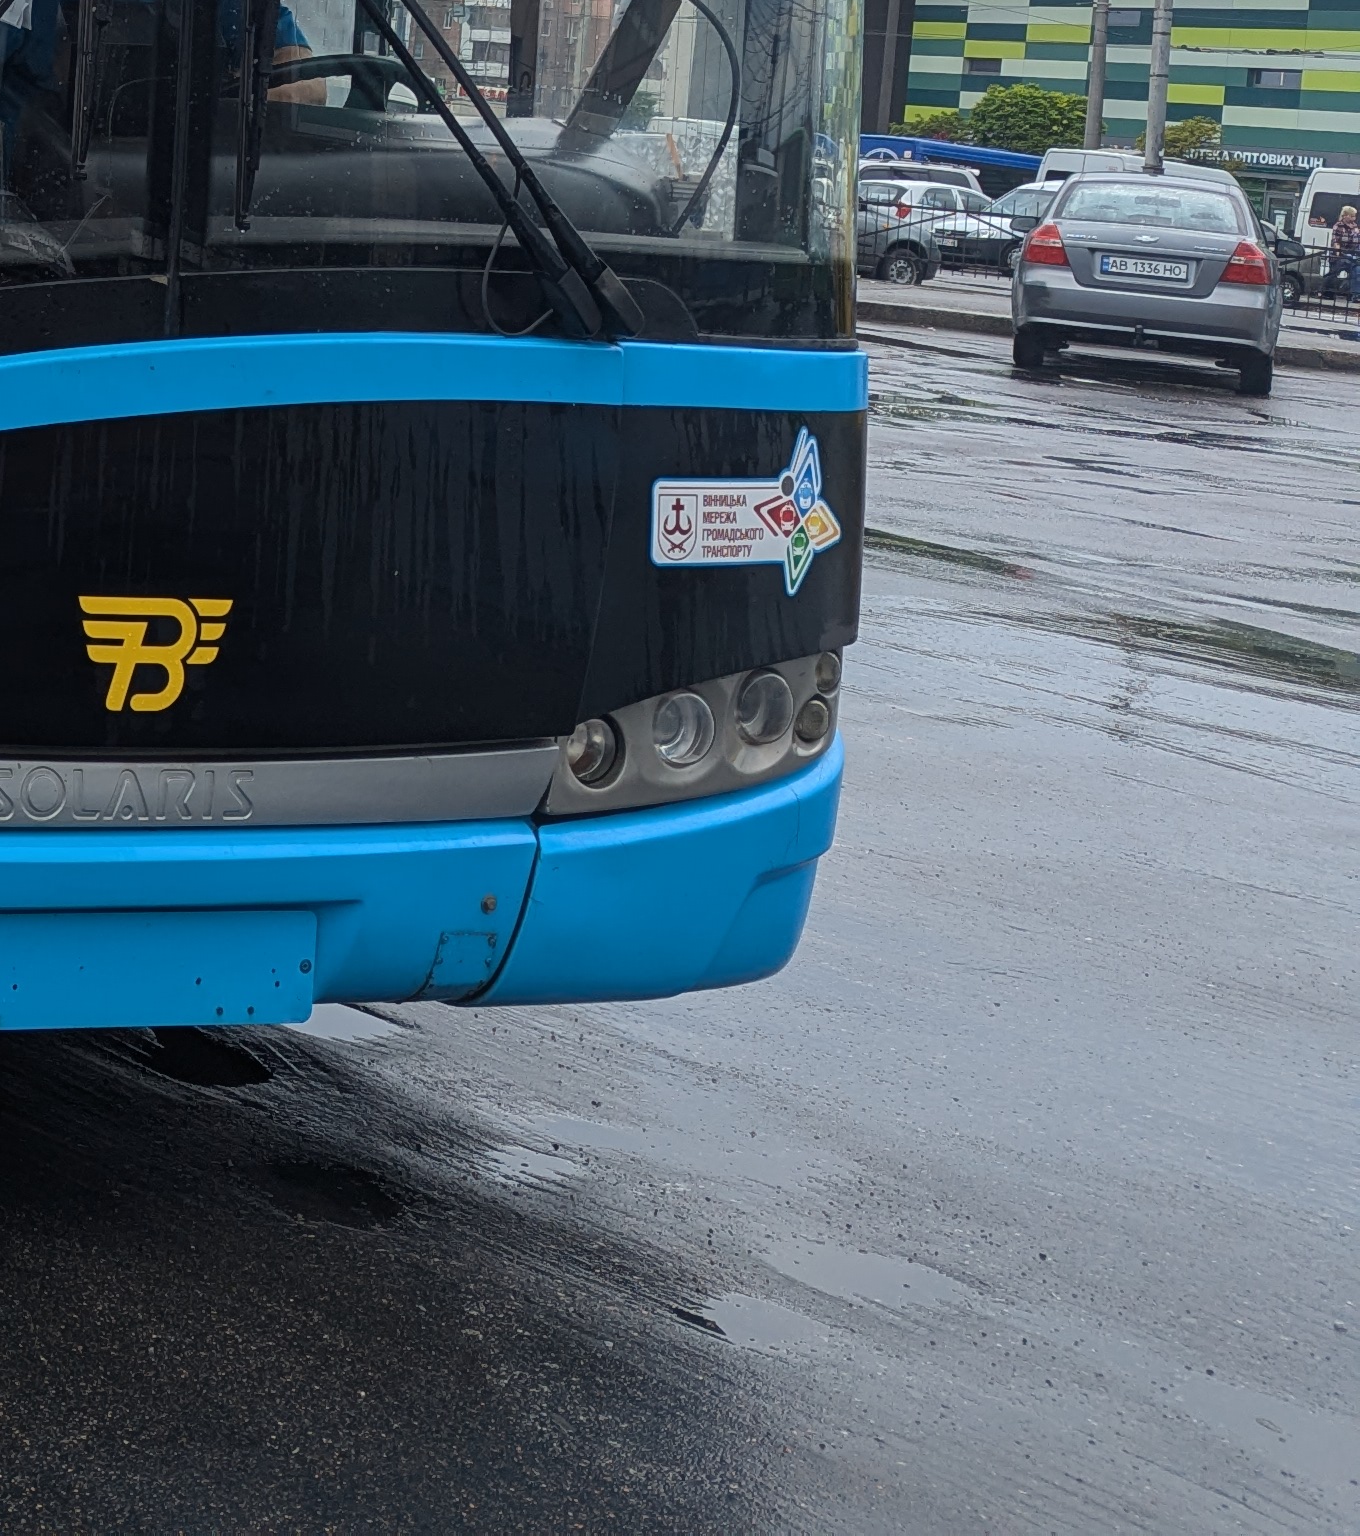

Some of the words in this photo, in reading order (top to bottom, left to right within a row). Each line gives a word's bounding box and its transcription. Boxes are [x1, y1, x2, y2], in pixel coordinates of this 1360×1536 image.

[1233, 151, 1294, 167] ОПТОВИХ
[1298, 156, 1324, 169] ЦІН
[1132, 261, 1160, 274] 1336
[702, 494, 747, 508] ВІННИЦЬКА
[702, 511, 738, 524] МЕРЕЖА
[701, 527, 765, 542] ГРОМАДСЬКОГО
[701, 544, 753, 559] ТРАНСПОРТУ
